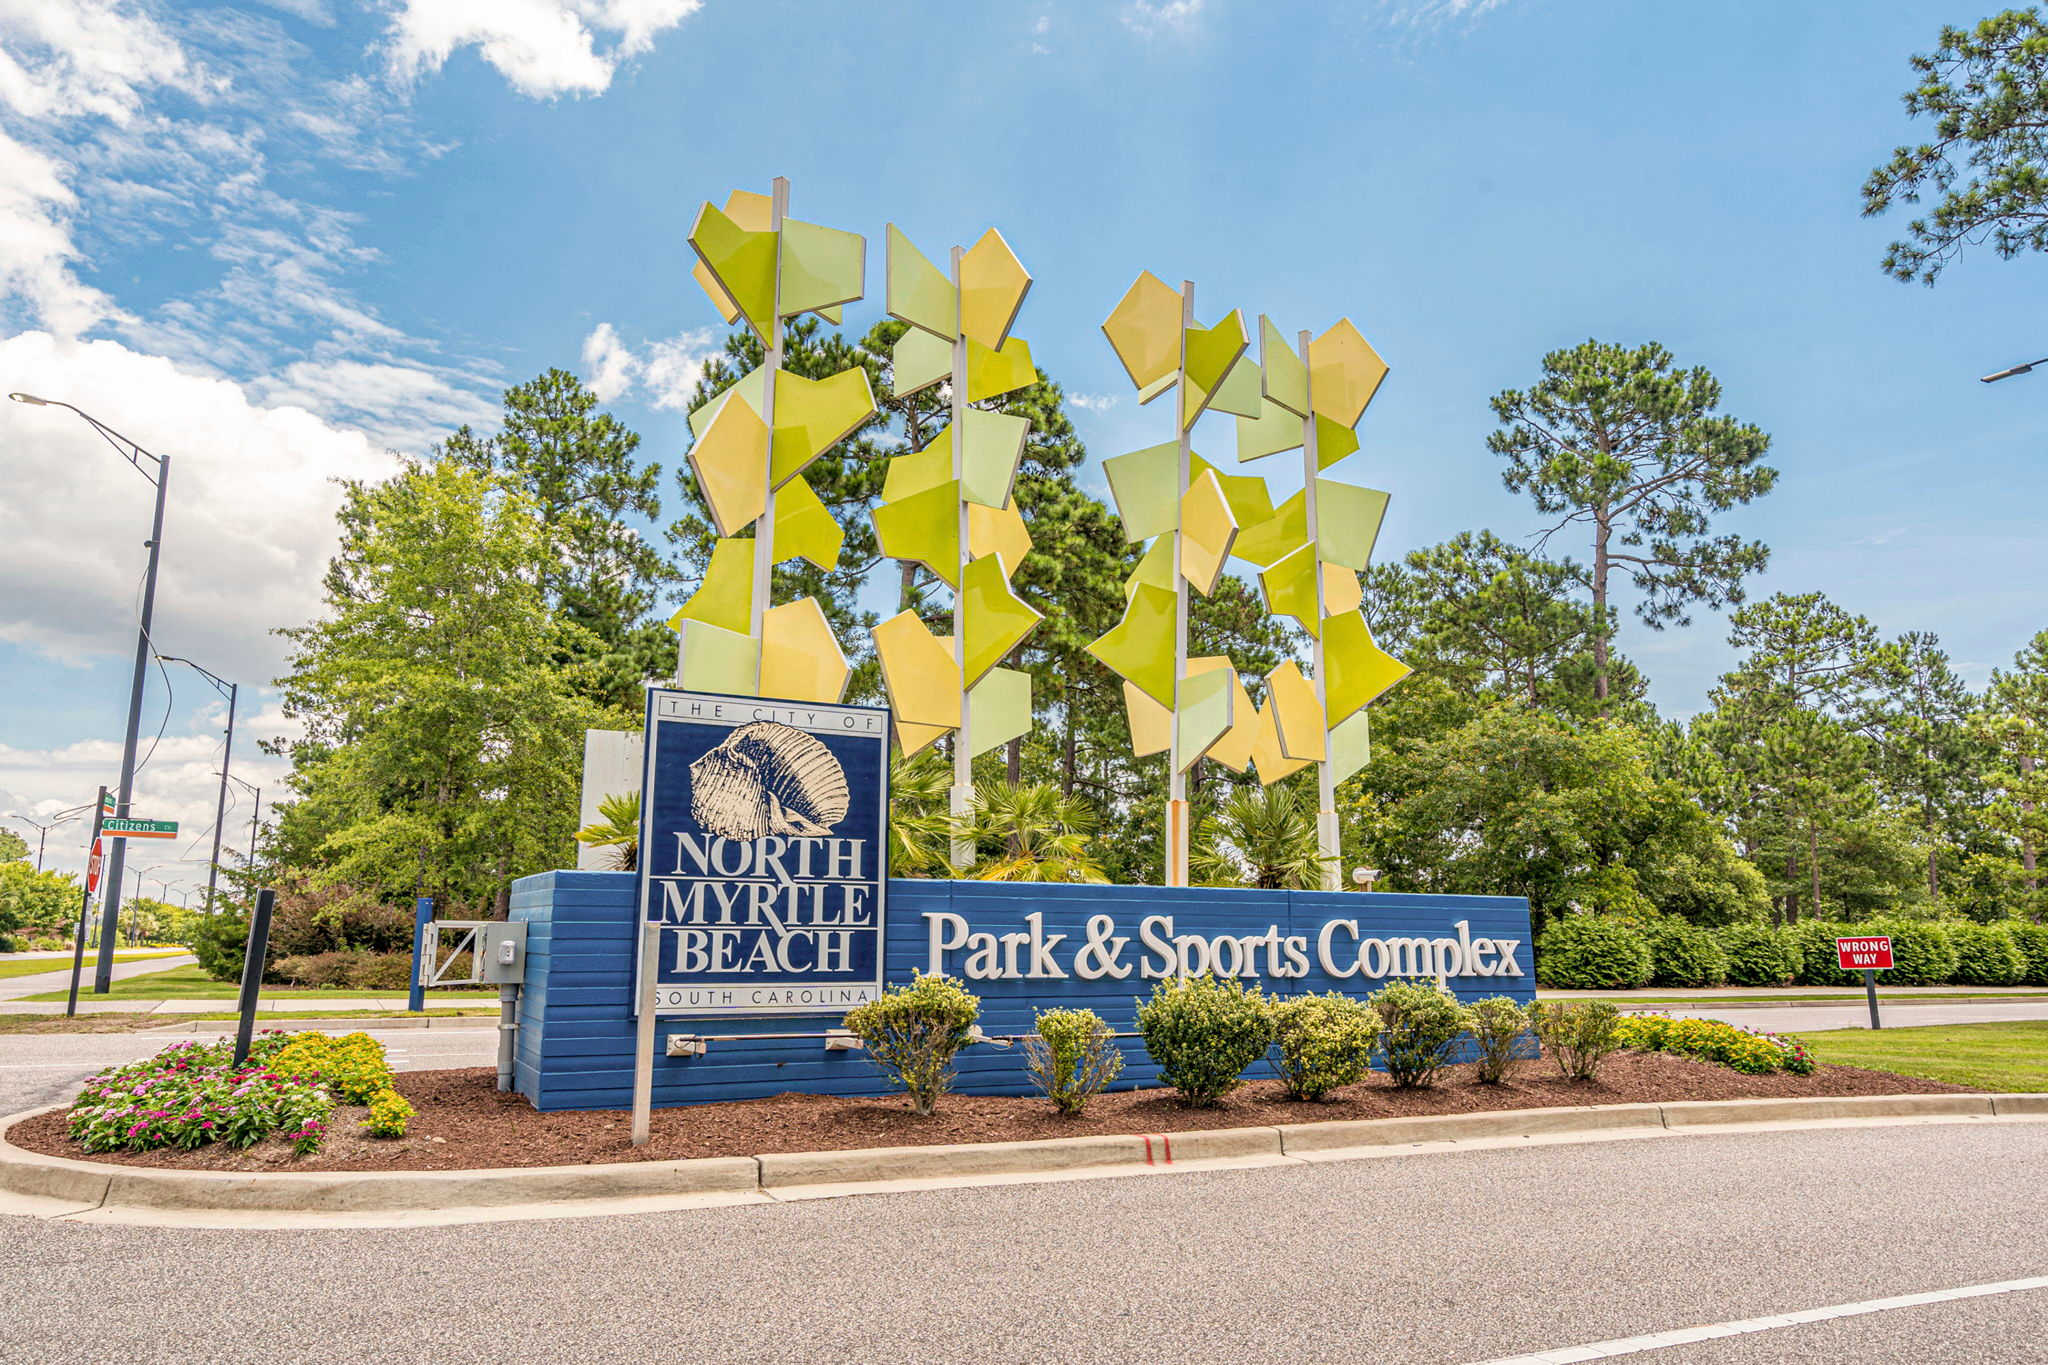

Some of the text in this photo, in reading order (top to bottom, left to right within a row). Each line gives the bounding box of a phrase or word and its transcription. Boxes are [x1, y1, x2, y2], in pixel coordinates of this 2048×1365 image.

[670, 701, 873, 729] THE CITY OF
[107, 820, 156, 831] Citizens
[671, 831, 867, 885] NORTH
[659, 880, 871, 934] MYRTLE
[670, 928, 855, 974] BEACH
[920, 911, 1525, 991] Park & Sports Complex
[1840, 941, 1888, 952] WRONG
[1853, 953, 1877, 964] WAY
[751, 990, 868, 1004] CAROLINA
